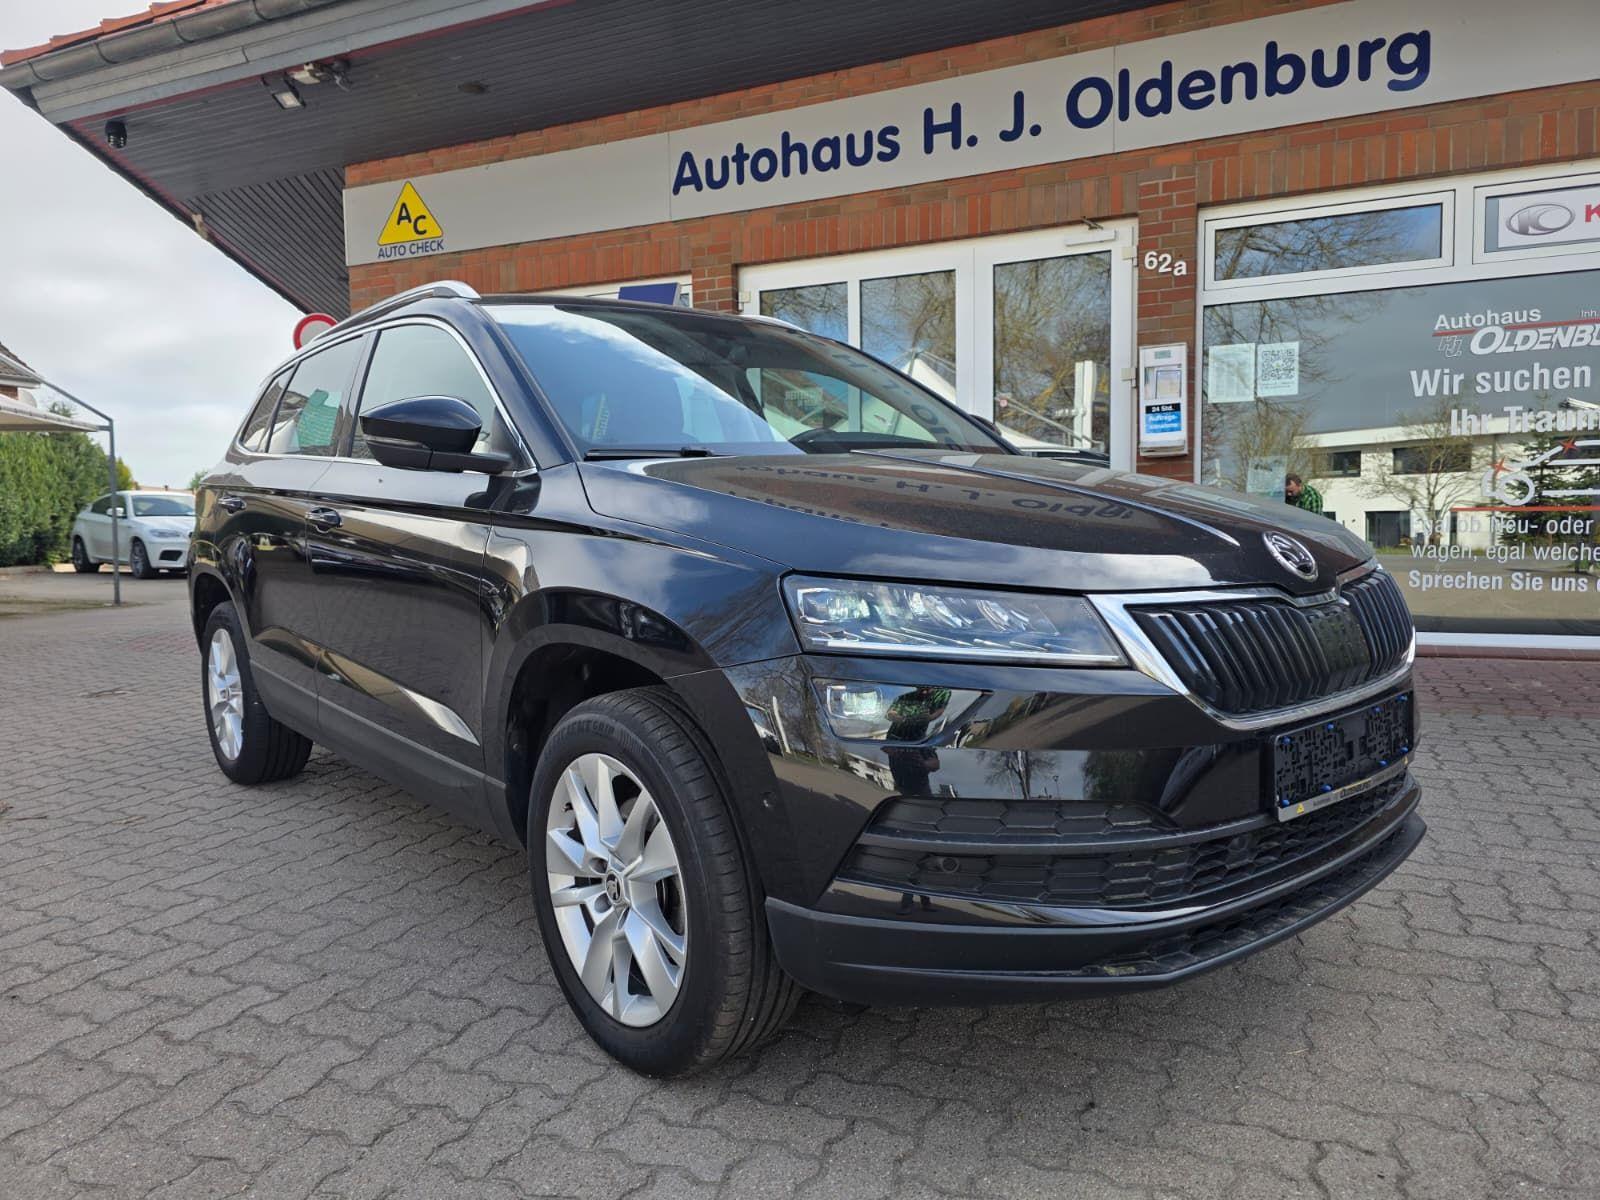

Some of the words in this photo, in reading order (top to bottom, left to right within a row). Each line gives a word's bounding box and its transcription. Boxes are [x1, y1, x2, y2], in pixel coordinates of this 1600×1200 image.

[672, 125, 901, 196] Autohaus
[923, 102, 978, 155] H.
[998, 90, 1042, 142] J.
[1065, 29, 1431, 129] Oldenburg
[377, 244, 407, 259] AUTO
[408, 239, 445, 255] CHECK
[1144, 251, 1187, 276] 62a
[1434, 308, 1542, 331] Autohaus
[1410, 368, 1464, 397] Wir
[1475, 362, 1591, 394] suchen
[1450, 408, 1493, 436] Ihr
[1546, 515, 1595, 535] oder
[1411, 543, 1478, 563] wagen,
[1486, 542, 1526, 564] egal
[1408, 569, 1503, 592] Sprechen
[1510, 571, 1544, 592] Sie
[1551, 576, 1588, 592] uns
